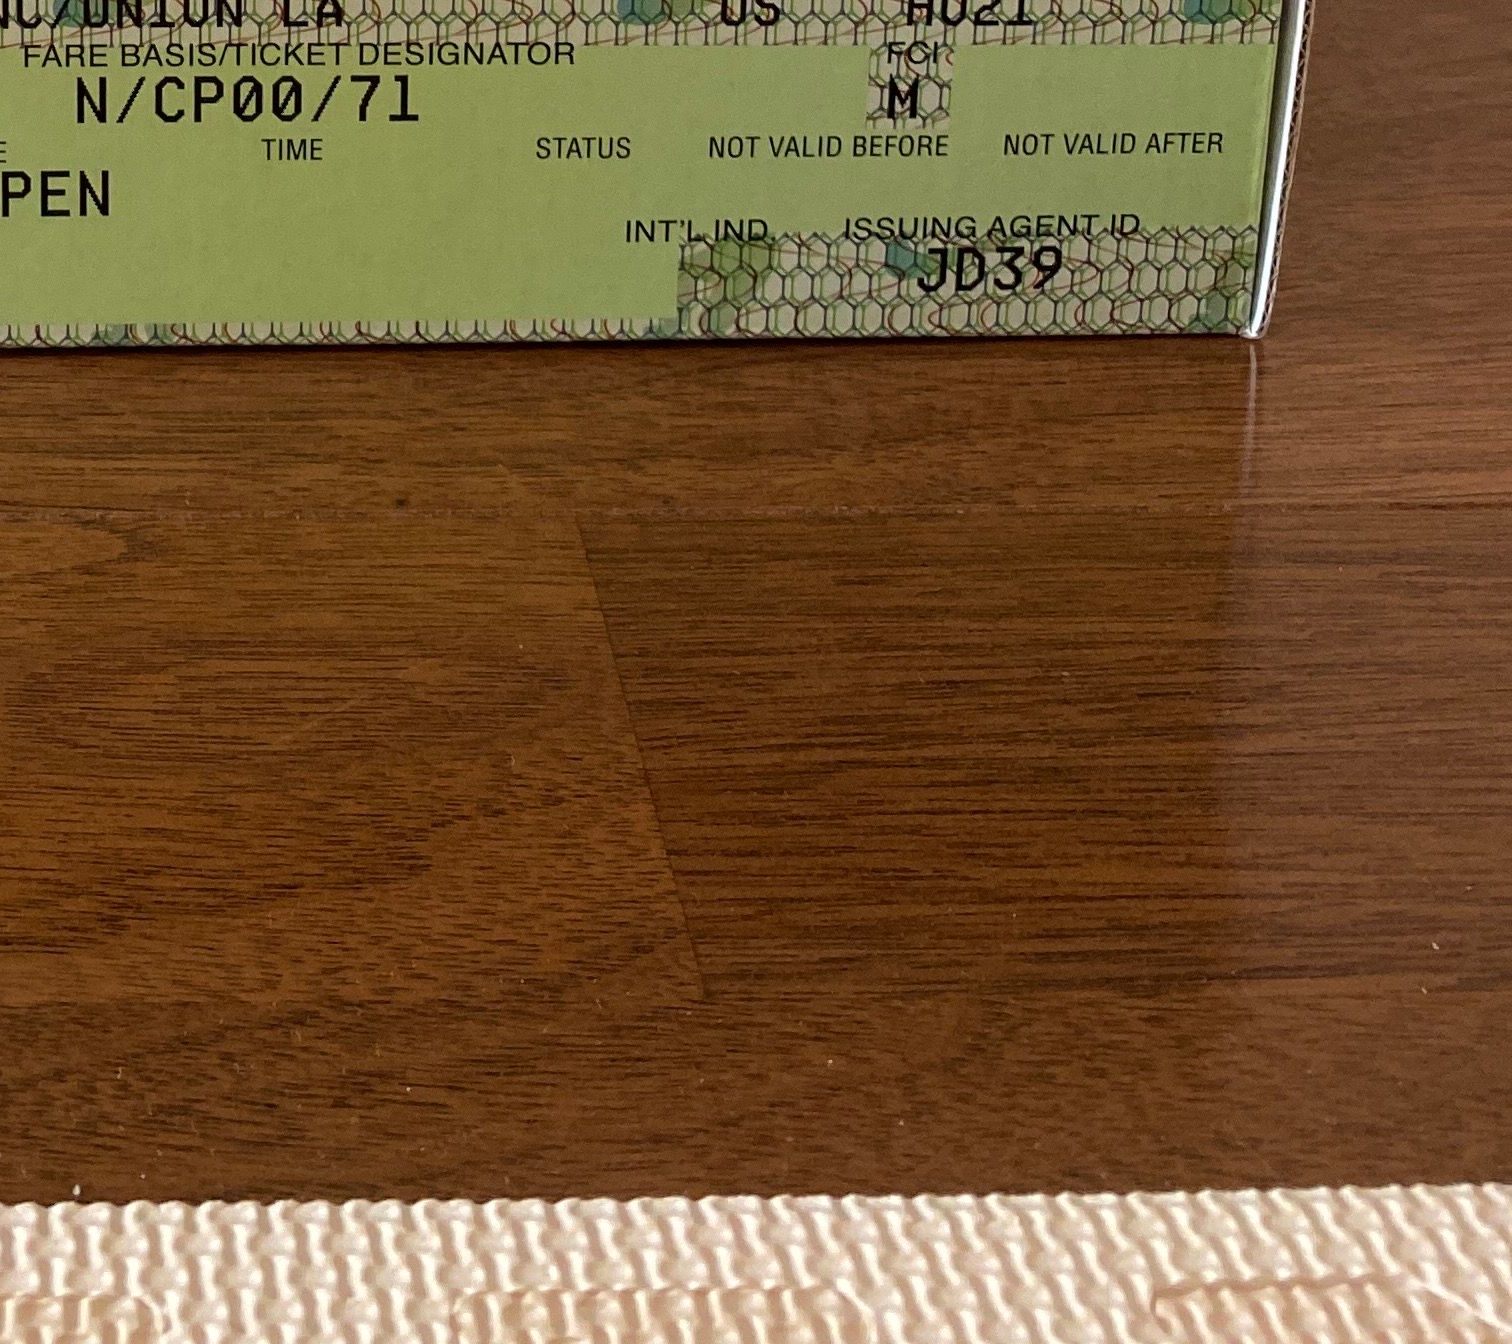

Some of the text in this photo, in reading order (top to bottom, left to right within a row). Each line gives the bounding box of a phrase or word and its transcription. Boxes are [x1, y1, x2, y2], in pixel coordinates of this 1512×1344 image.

[22, 40, 576, 69] FARE BASIS/TICKET DESIGNATOR
[887, 41, 940, 65] FCI
[75, 73, 421, 126] N/CP00/71
[888, 75, 921, 121] M
[260, 137, 324, 162] TIME
[535, 136, 632, 161] STATUS
[708, 134, 950, 159] NOT VALID BEFORE
[1002, 131, 1224, 157] NOT VALID AFTER
[624, 218, 704, 243] INT'L
[843, 213, 1141, 241] ISSUING AGENT ID
[916, 244, 1064, 293] JD39
